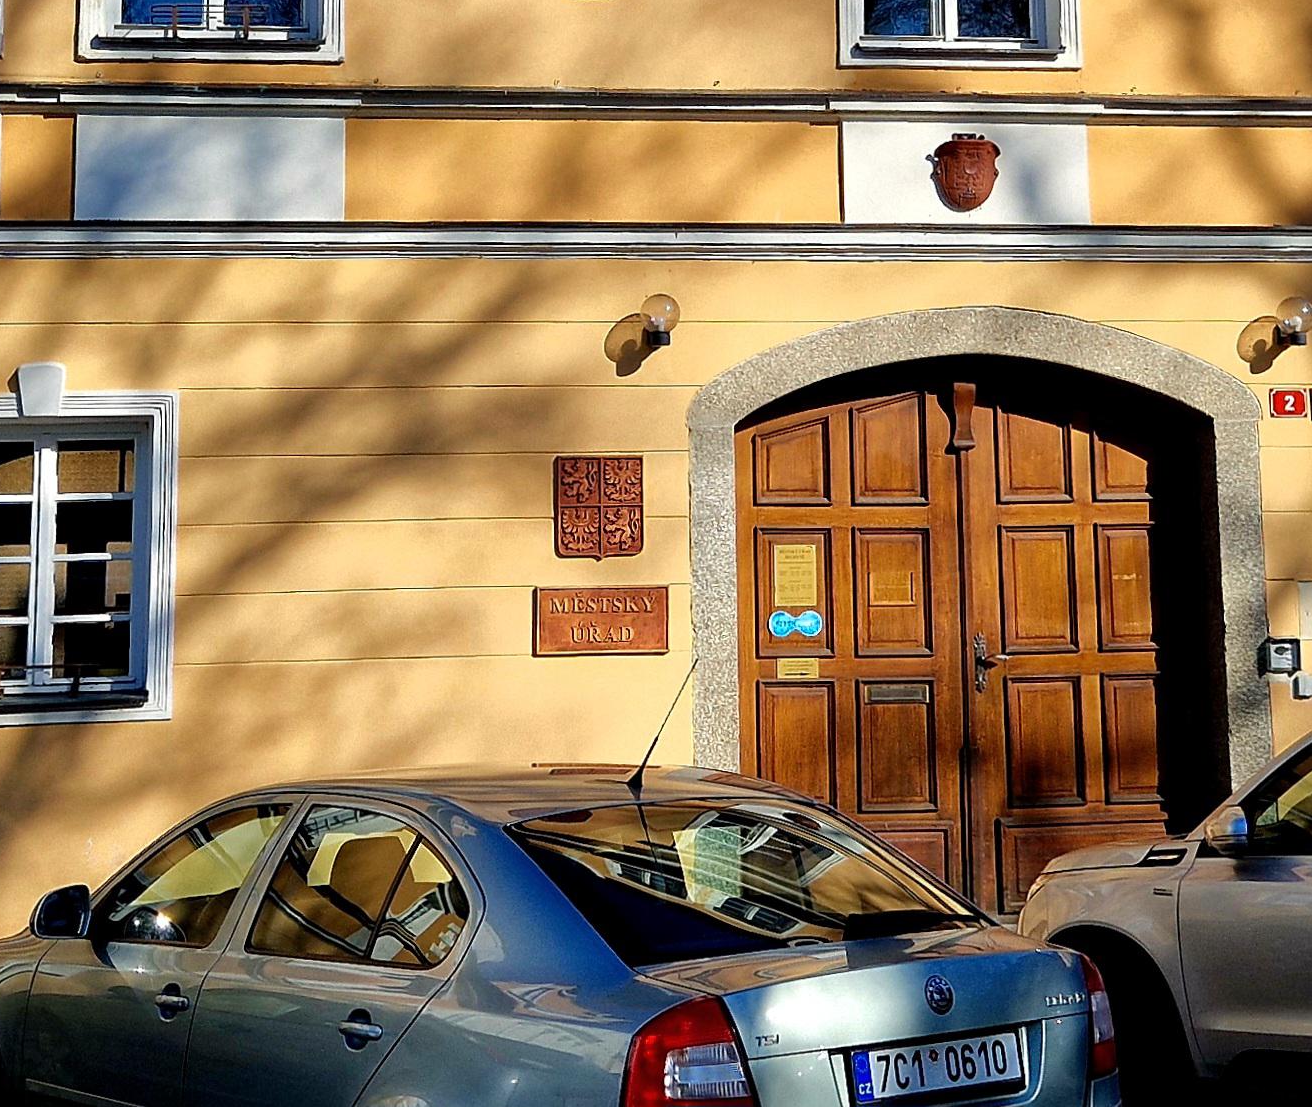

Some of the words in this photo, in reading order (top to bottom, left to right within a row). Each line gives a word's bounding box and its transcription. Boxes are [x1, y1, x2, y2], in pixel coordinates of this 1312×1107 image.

[1284, 395, 1295, 412] 2
[549, 591, 656, 614] MĚSTSKÝ
[571, 621, 635, 644] ÚŘAD
[755, 1034, 779, 1047] TSI
[876, 1049, 926, 1093] 7C1
[944, 1039, 1008, 1083] 0610
[858, 1082, 873, 1096] CZ
